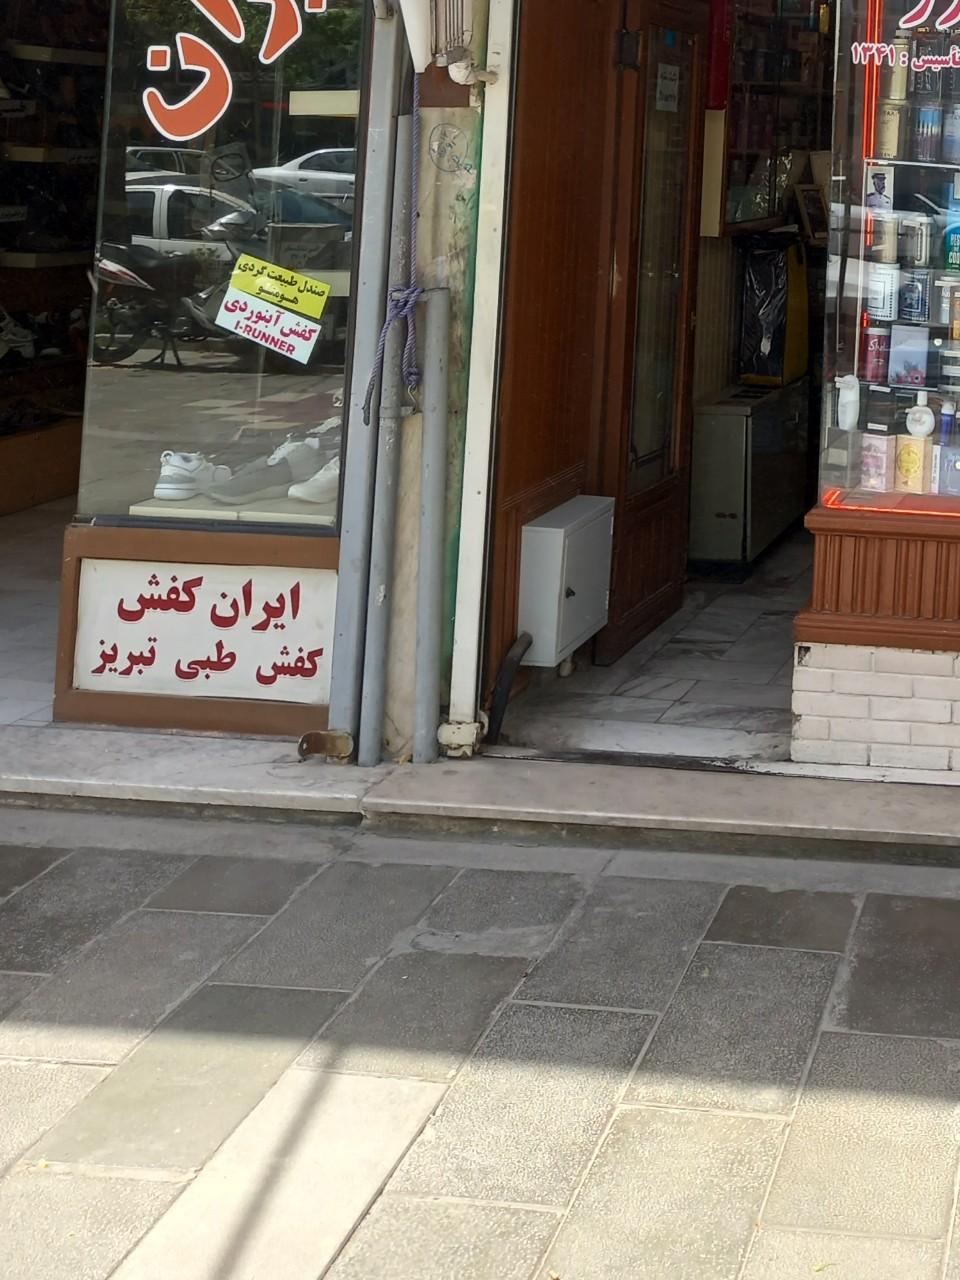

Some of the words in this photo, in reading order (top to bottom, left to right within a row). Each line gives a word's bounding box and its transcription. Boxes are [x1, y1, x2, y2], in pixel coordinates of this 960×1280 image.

[851, 42, 896, 65] ۱۳۴۱
[267, 271, 298, 288] طبیعت
[298, 280, 325, 297] صندل
[234, 321, 296, 355] I-RUNNER
[280, 322, 317, 341] کفش
[117, 573, 203, 623] کفش
[209, 578, 301, 631] ایران
[91, 636, 158, 677] تبریز
[174, 640, 237, 682] طبی
[255, 646, 324, 687] کفش
